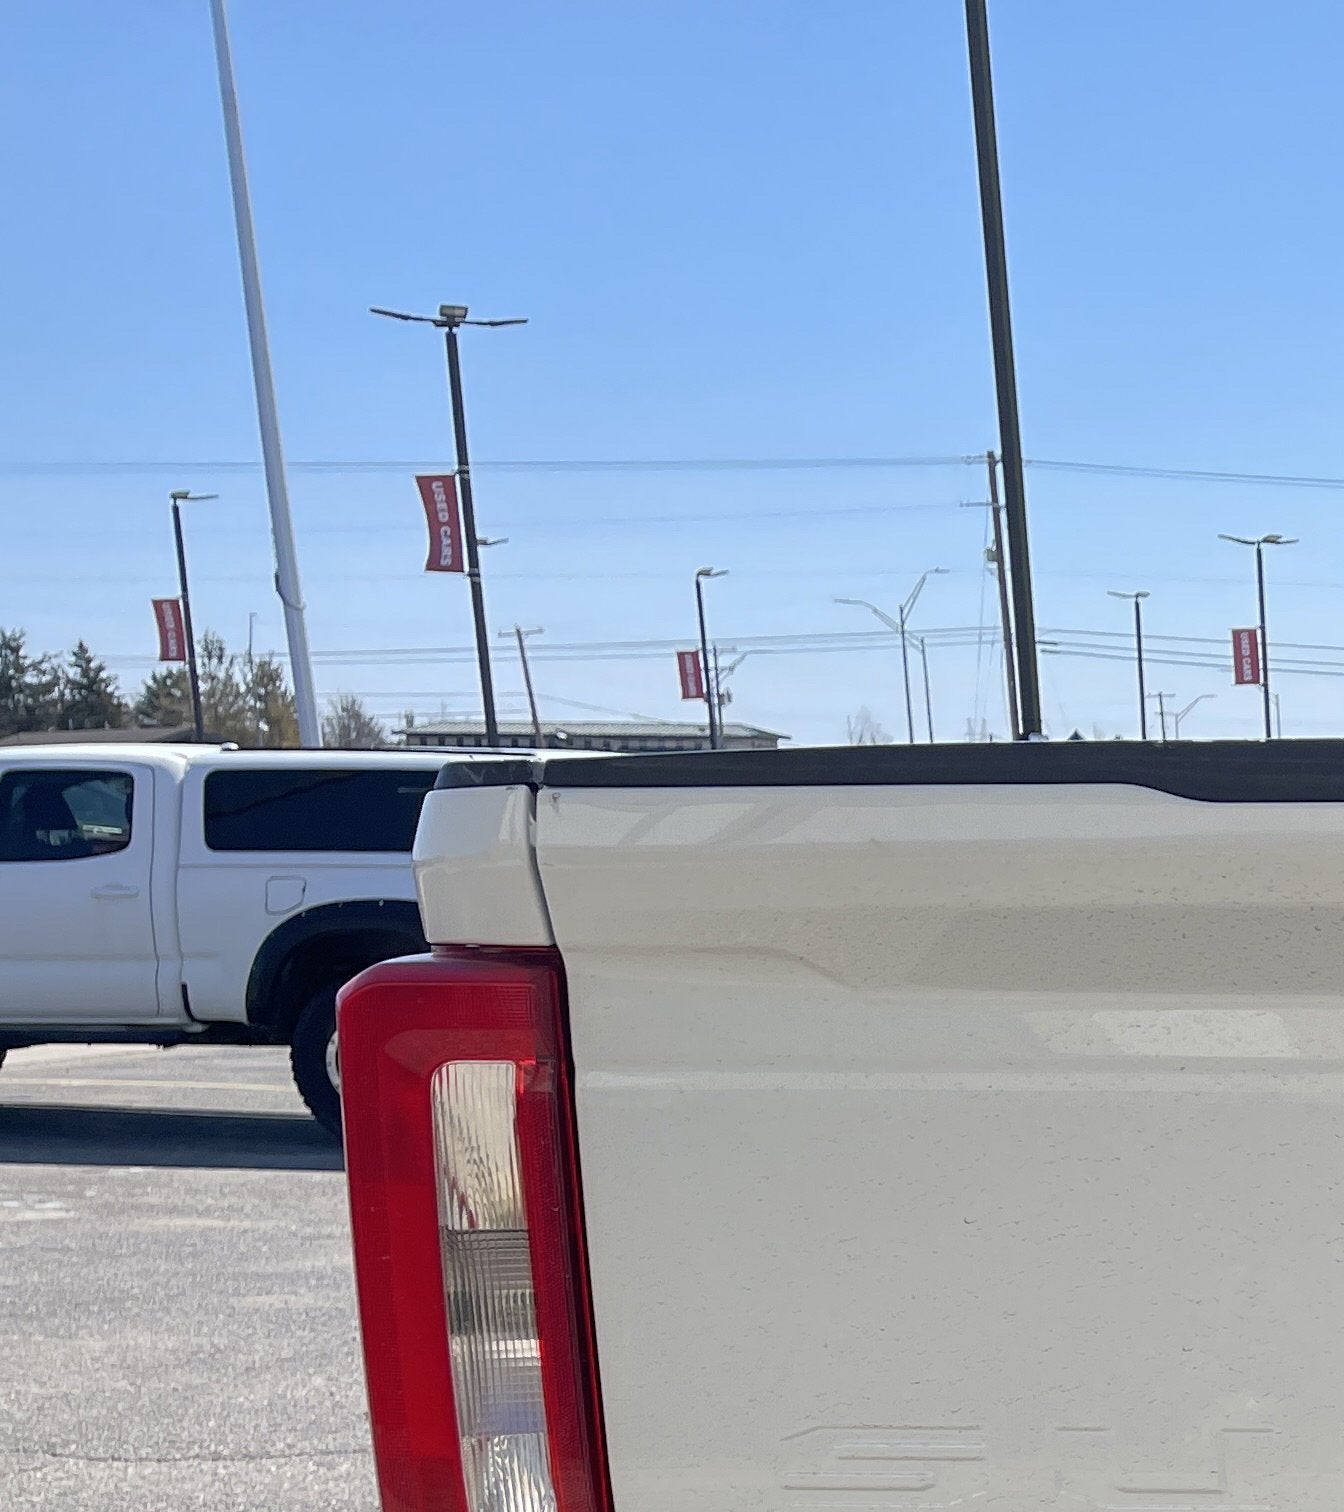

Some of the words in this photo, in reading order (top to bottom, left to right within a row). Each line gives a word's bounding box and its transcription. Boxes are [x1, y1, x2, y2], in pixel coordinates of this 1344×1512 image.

[432, 481, 449, 523] USED
[440, 525, 453, 566] CARS
[1240, 631, 1250, 656] USED
[1242, 657, 1253, 681] CARS
